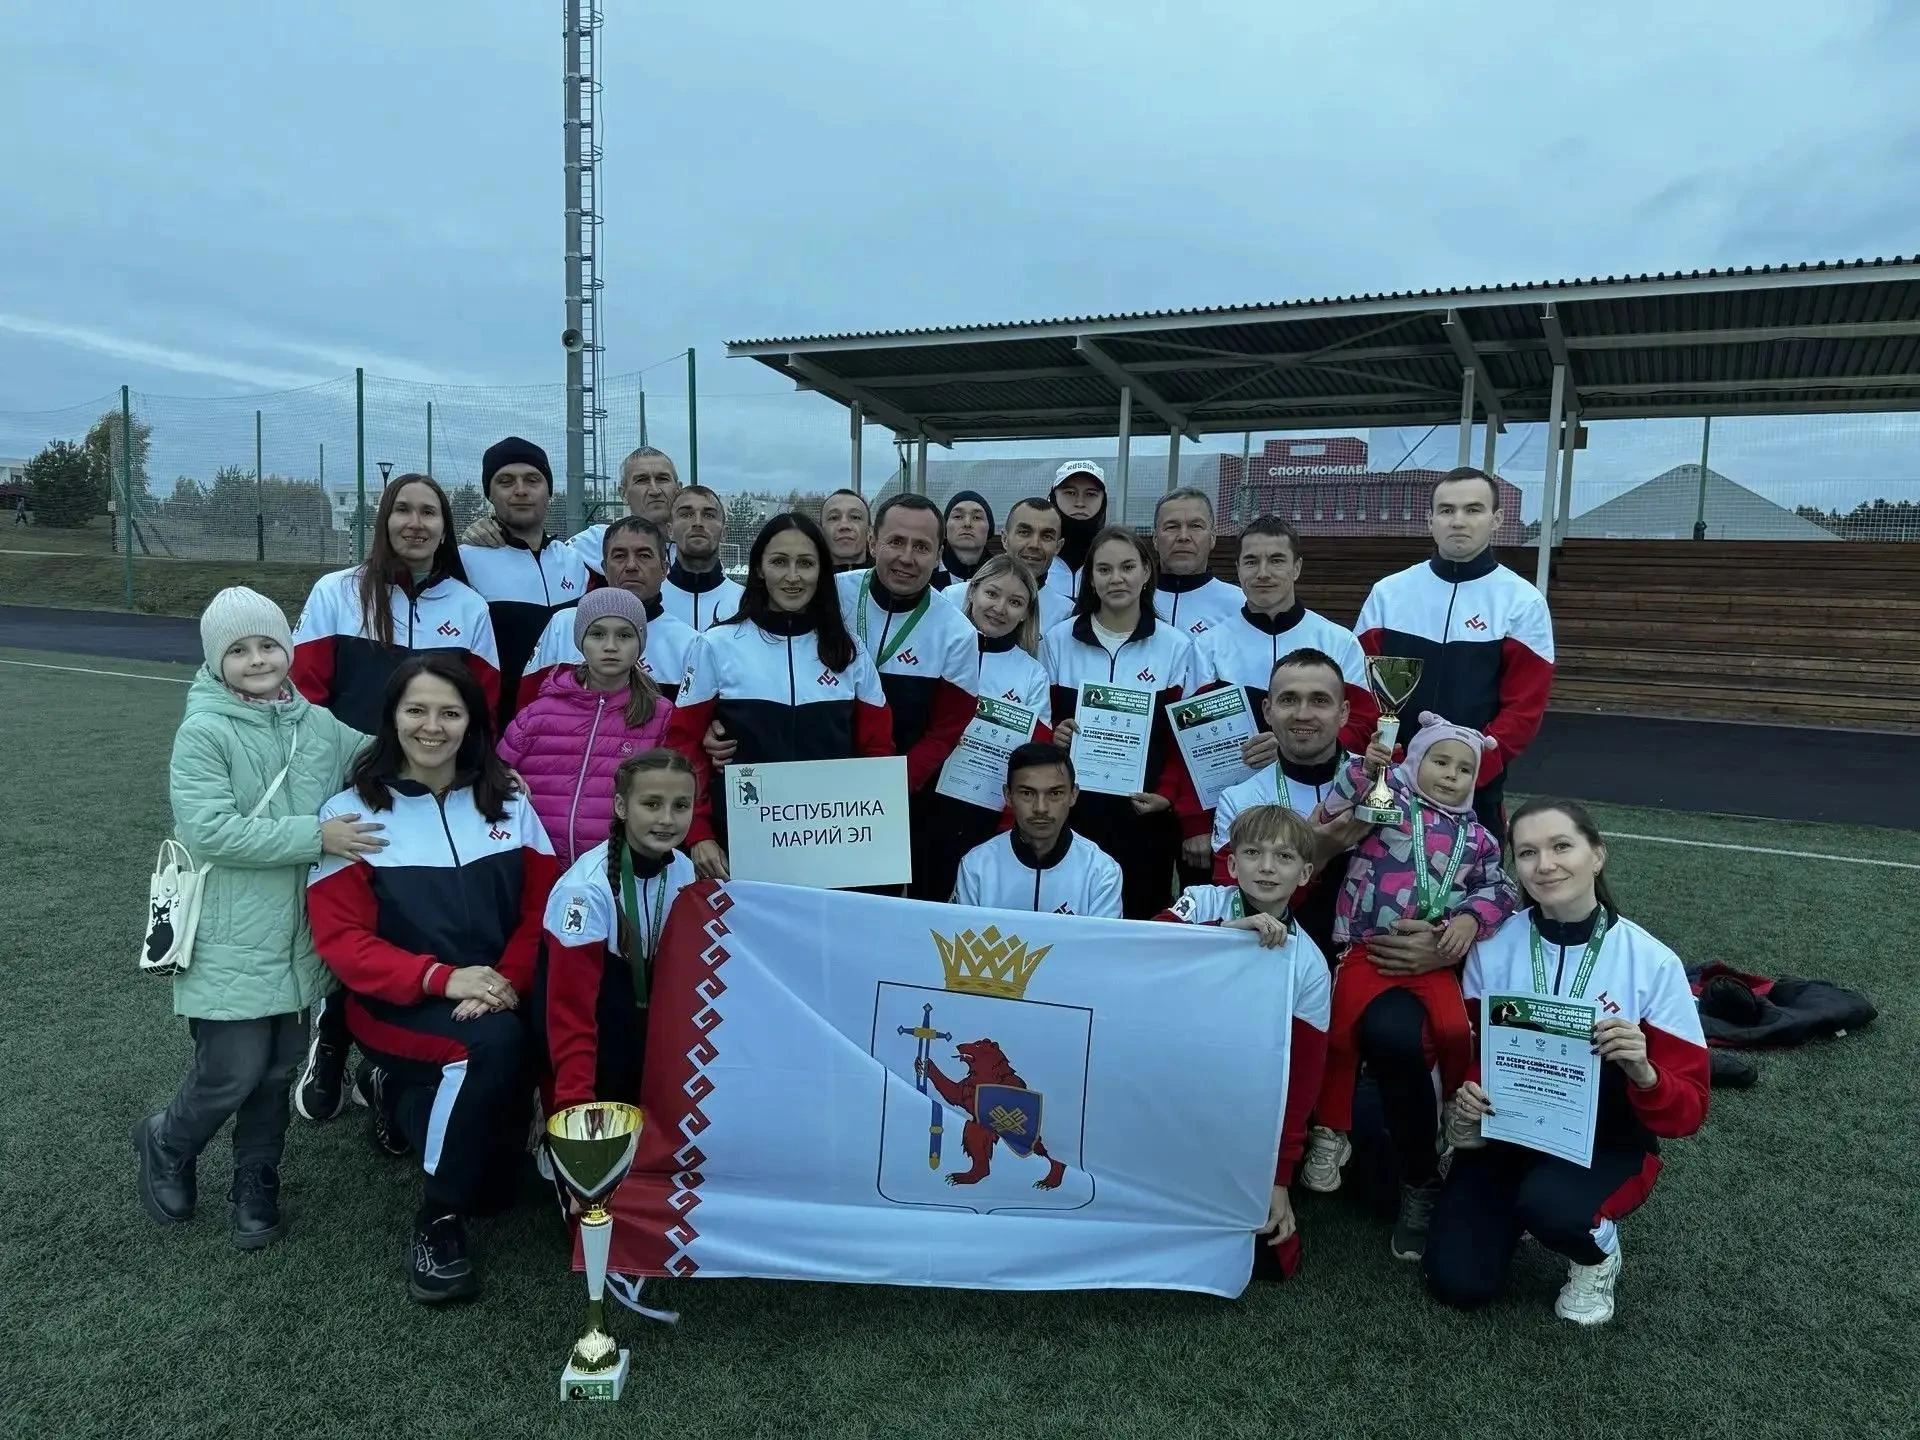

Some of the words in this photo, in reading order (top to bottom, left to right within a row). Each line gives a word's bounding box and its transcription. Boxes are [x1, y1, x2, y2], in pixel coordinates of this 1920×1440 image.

[1067, 462, 1095, 471] RUSSIA
[760, 800, 884, 822] РЕСПУБЛИКА
[772, 825, 842, 848] МАРИЙ
[848, 826, 872, 843] ЭЛ
[597, 1385, 603, 1394] 1
